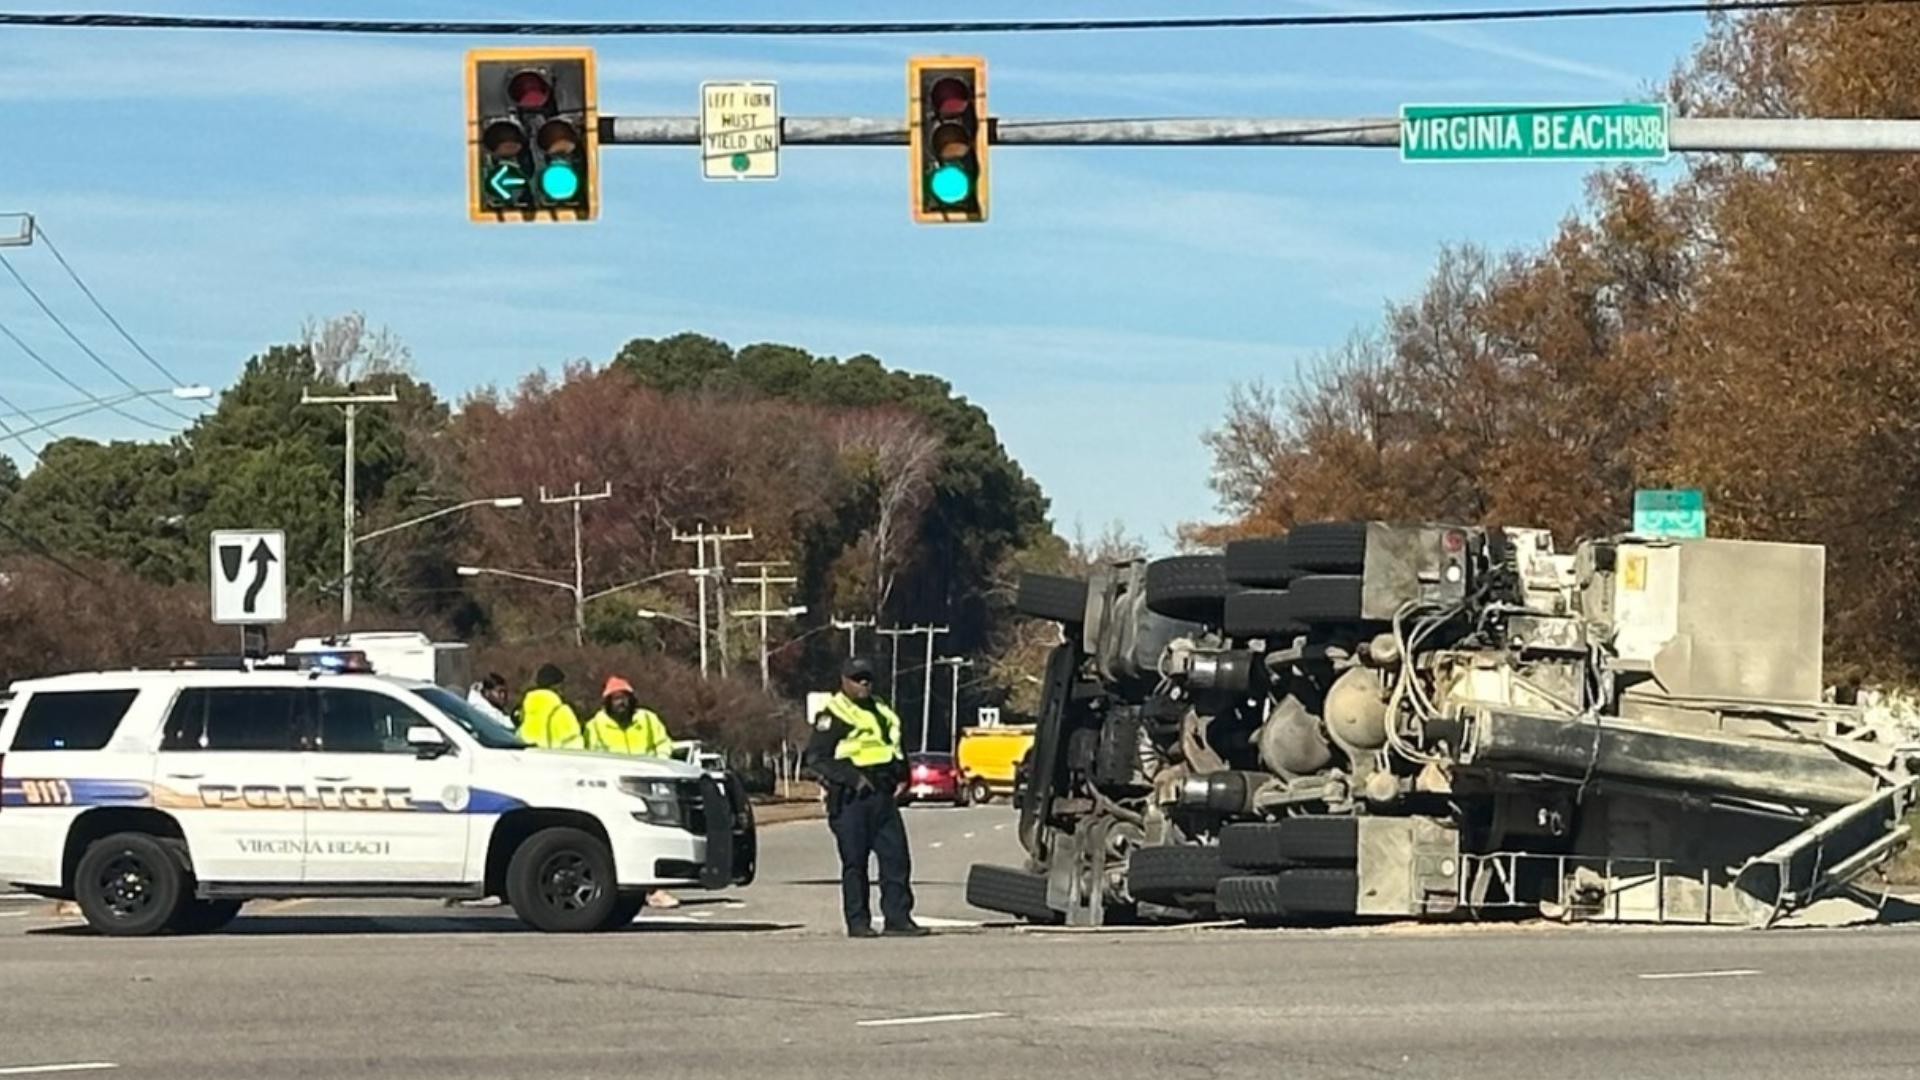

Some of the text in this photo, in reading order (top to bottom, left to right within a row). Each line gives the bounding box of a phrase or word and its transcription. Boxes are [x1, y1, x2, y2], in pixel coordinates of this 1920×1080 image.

[721, 114, 757, 128] MUST
[1624, 116, 1661, 134] BLVD
[1402, 115, 1622, 150] VIRGINIA BEACH
[708, 134, 773, 149] YIELD ON
[198, 785, 418, 812] POLICE
[237, 839, 390, 855] VIRGINIA BEACH
